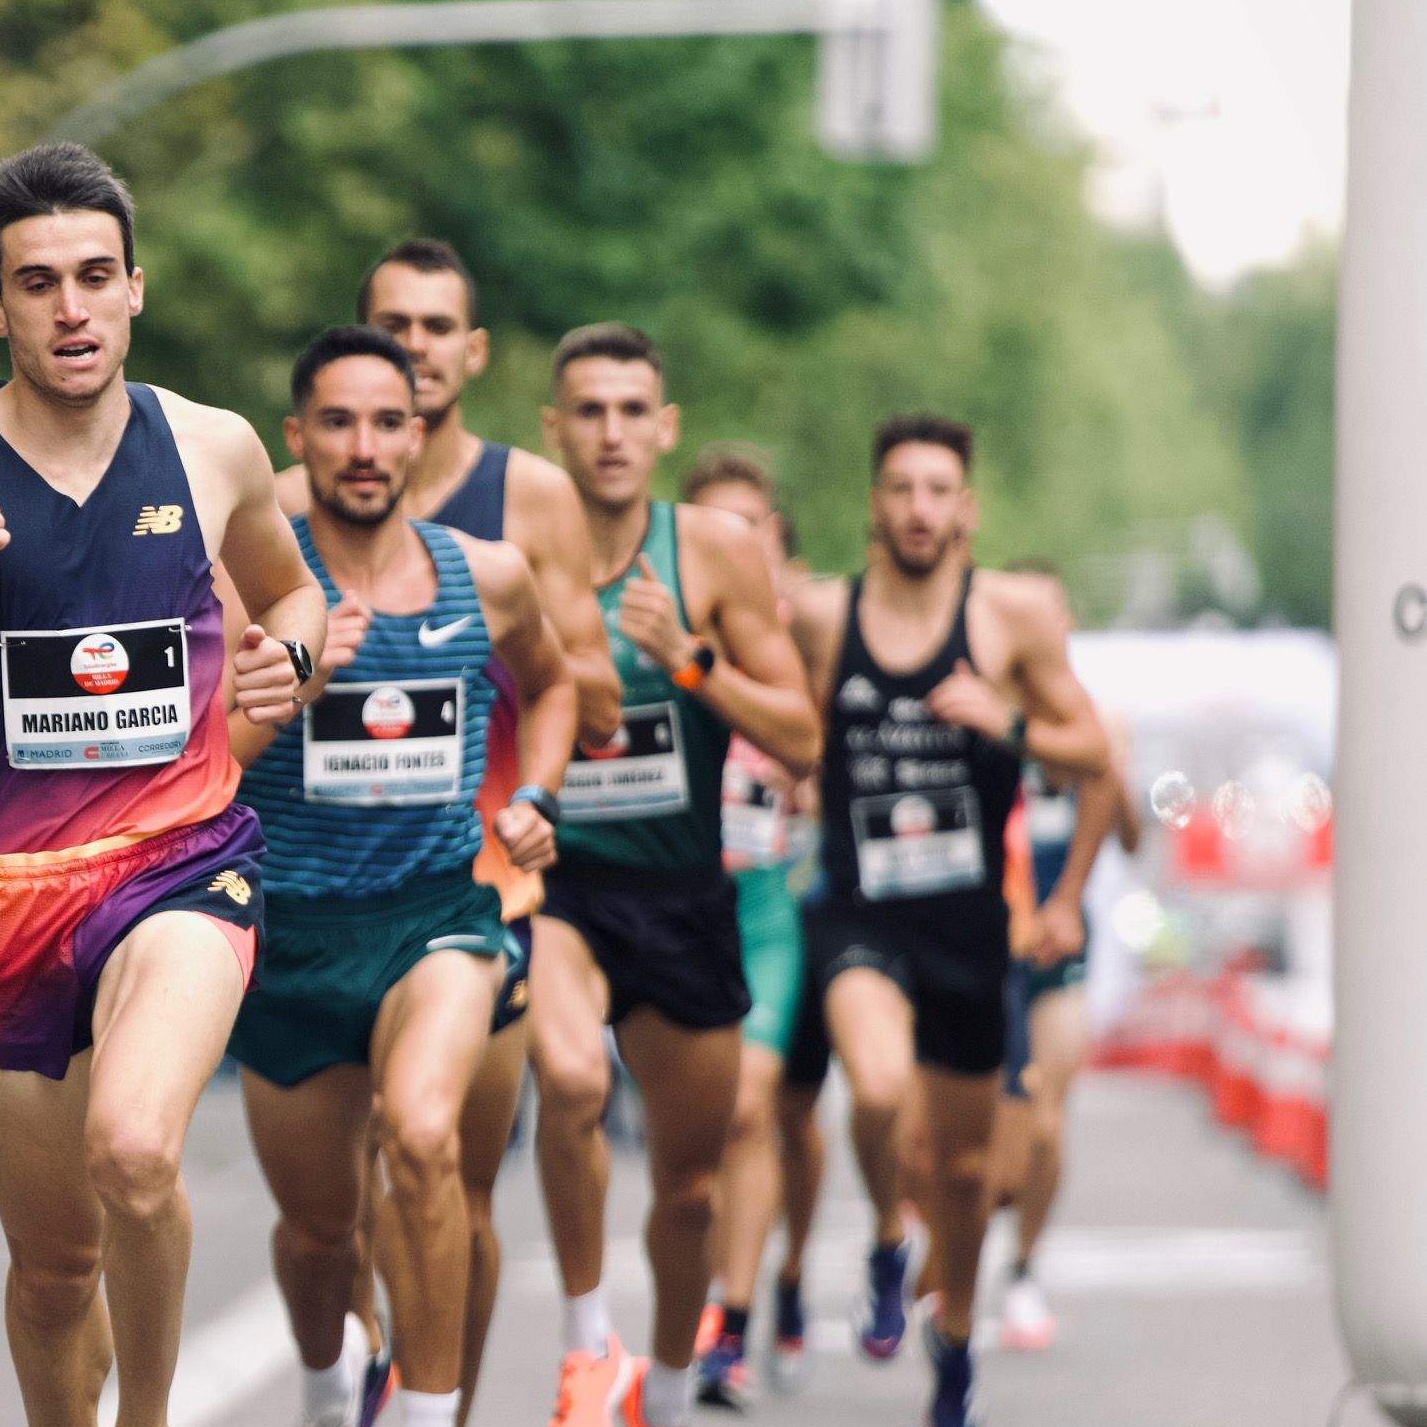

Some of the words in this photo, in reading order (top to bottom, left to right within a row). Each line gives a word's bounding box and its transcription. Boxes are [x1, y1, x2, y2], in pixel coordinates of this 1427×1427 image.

[164, 646, 175, 668] 1
[22, 712, 108, 733] MARIANO
[116, 704, 178, 729] GARCIA
[30, 749, 72, 759] MADRID
